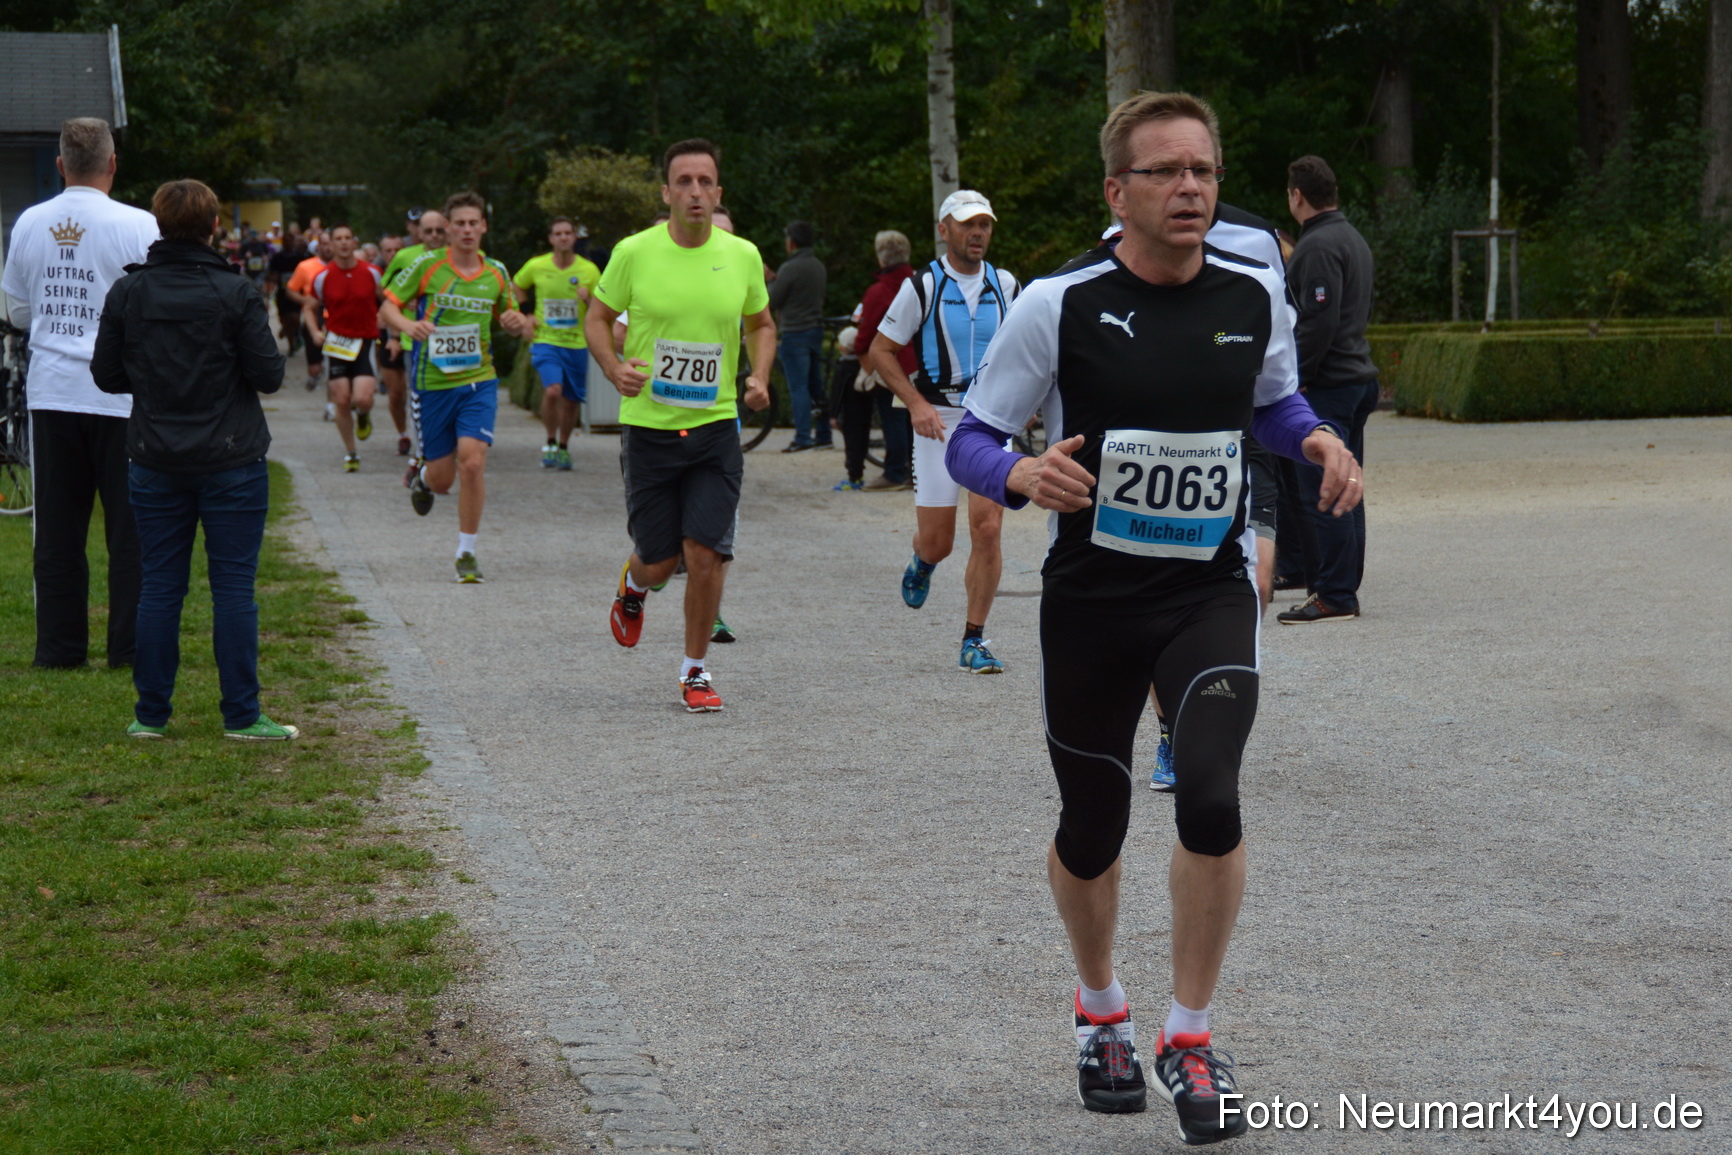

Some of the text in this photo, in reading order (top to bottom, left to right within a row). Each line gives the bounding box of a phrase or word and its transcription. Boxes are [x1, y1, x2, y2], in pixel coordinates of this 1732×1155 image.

[60, 248, 75, 261] IM
[43, 266, 95, 283] UFTRAG
[45, 284, 88, 300] SEINER
[434, 293, 494, 314] BOCK
[50, 321, 84, 337] JESUS
[435, 336, 477, 354] 2826
[1217, 335, 1254, 343] CAPTRAIN
[656, 343, 680, 354] PARTL
[660, 355, 717, 383] 2780
[664, 385, 708, 400] Benjamin
[1106, 441, 1222, 458] PARTL Neumarkt
[1113, 461, 1228, 512] 2063
[1129, 518, 1204, 542] Michael
[1200, 689, 1237, 699] adidas
